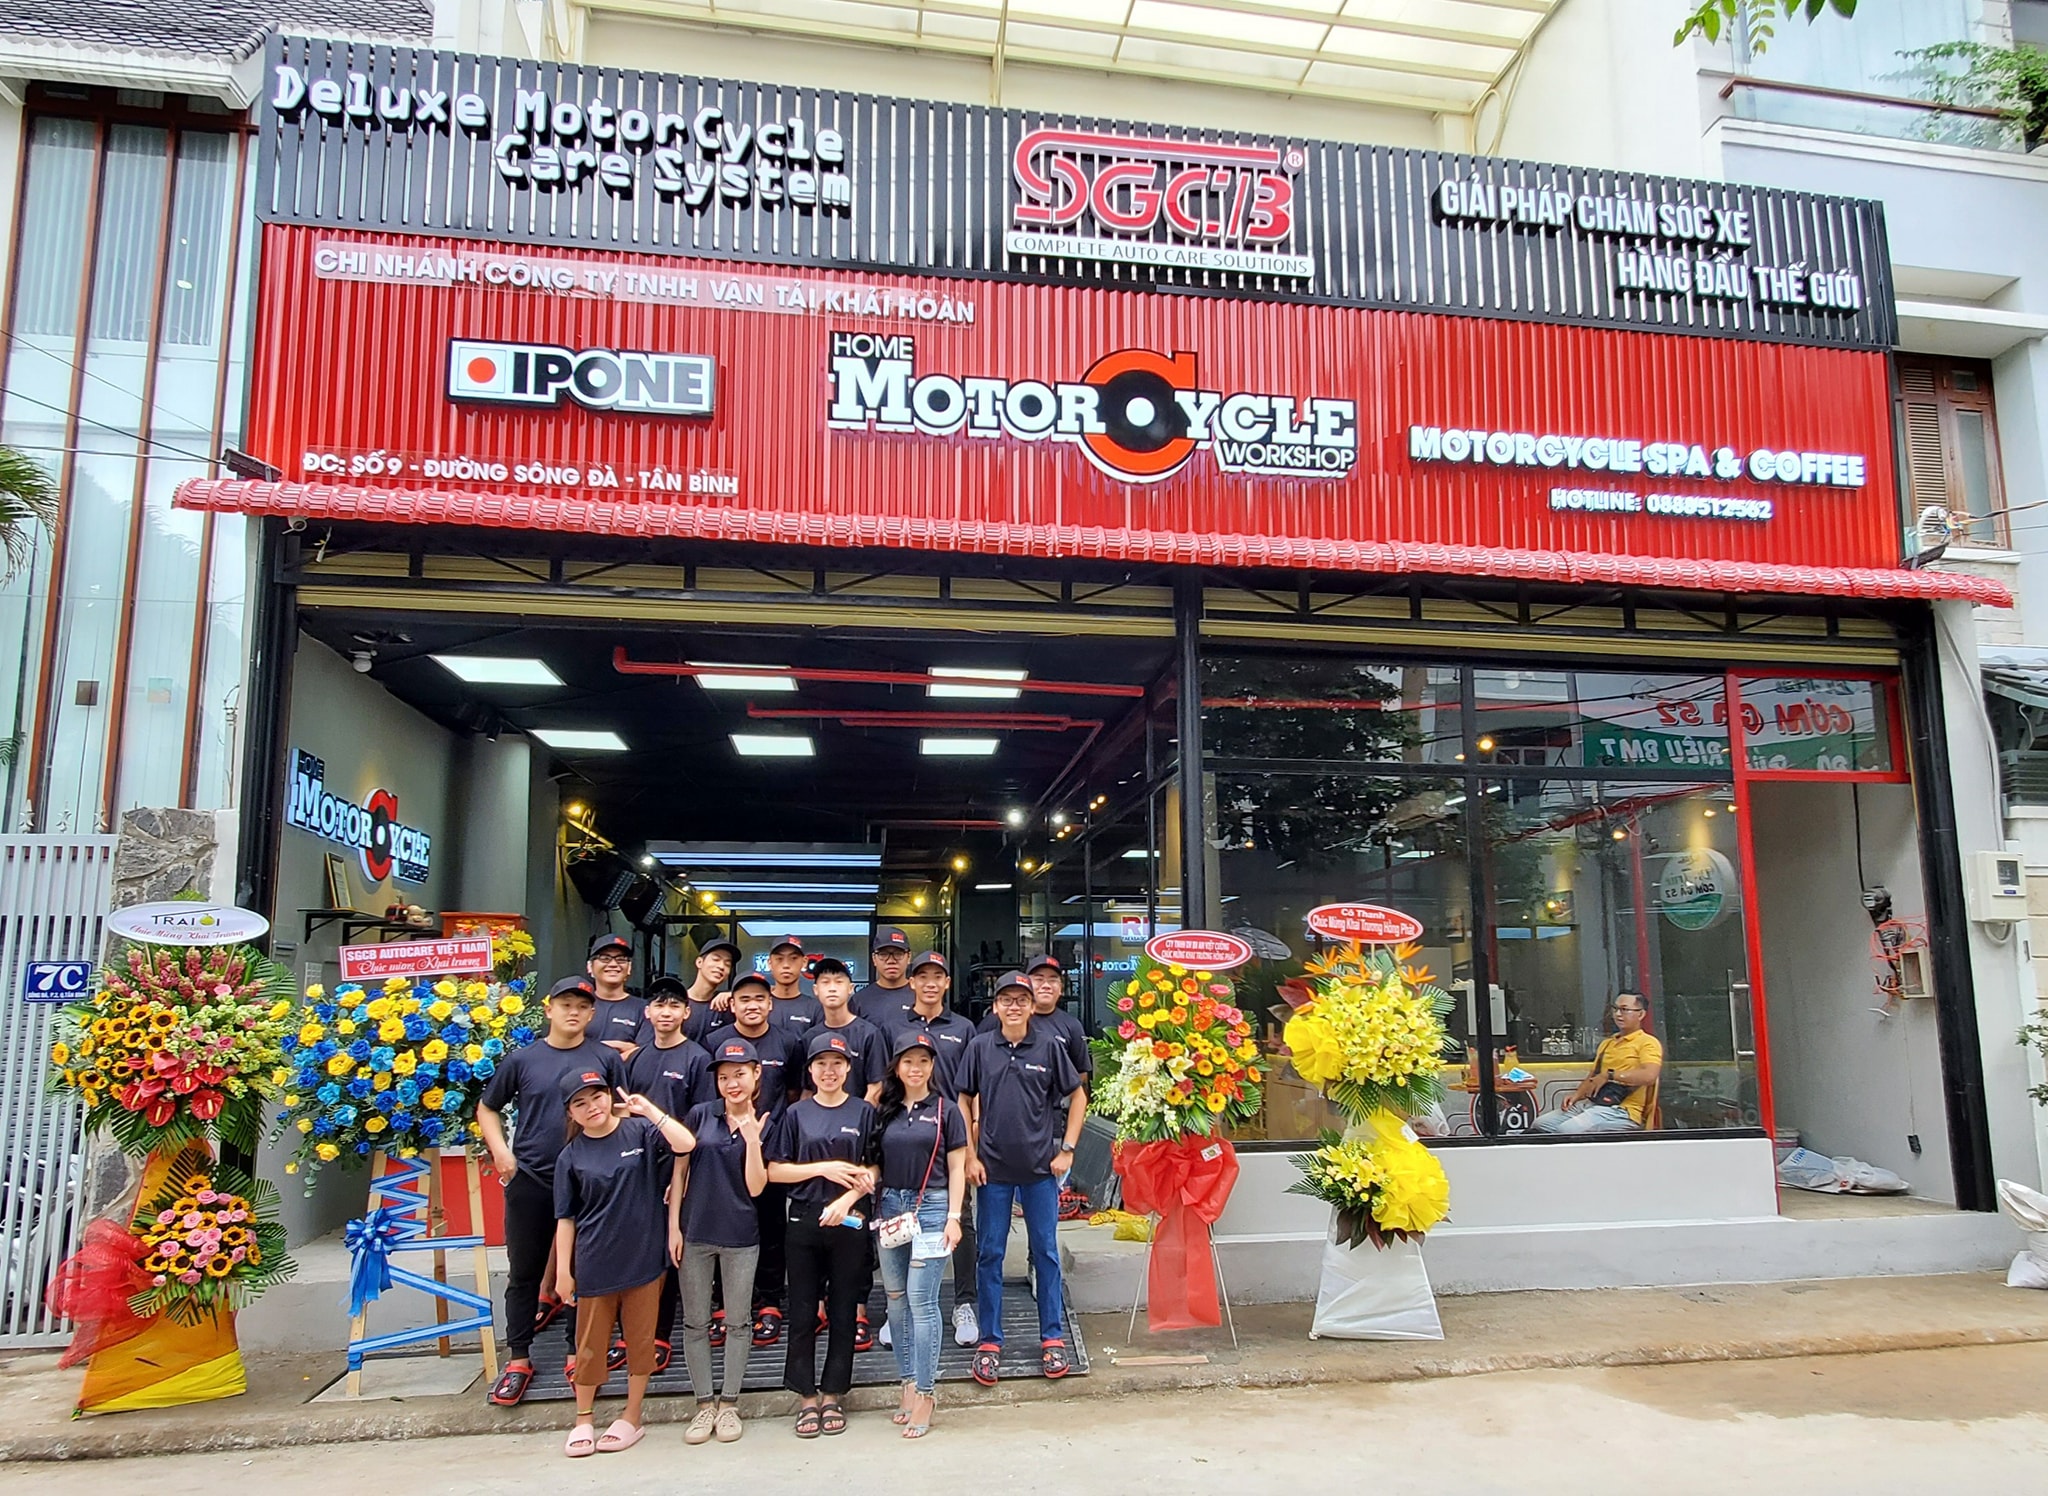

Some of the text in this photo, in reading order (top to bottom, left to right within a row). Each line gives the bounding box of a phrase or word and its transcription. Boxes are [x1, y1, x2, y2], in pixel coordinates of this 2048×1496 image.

[273, 66, 844, 162] Deluxe MotorCycle
[495, 134, 852, 206] Care System
[1440, 172, 1752, 244] GIẢI PHÁP CHĂM SÓC XE
[1013, 236, 1308, 274] COMPLETE AUTO CARE SOLUTIONS
[314, 249, 974, 323] CHI NHÁNH CÔNG TY TNHH VẬN TẢI KHẢI HOÀN
[1617, 247, 1861, 309] HÀNG ĐẦU THẾ GIỚI
[834, 334, 913, 358] HOME
[513, 351, 705, 405] IPONE
[303, 452, 346, 474] ĐC:
[352, 450, 386, 475] SỐ
[387, 457, 403, 476] 9
[423, 456, 509, 483] ĐƯỜNG
[514, 462, 580, 486] SÔNG
[587, 464, 619, 488] ĐÀ
[638, 468, 682, 492] TÂN
[688, 469, 738, 495] BÌNH
[1221, 440, 1356, 472] WORKSHOP
[1410, 425, 1866, 487] MOTORCYCLE SPA & COFFEE
[1550, 488, 1642, 512] HOTLINE:
[1356, 909, 1386, 919] Thanh
[346, 943, 487, 962] SGCB AUTOCARE VIỆT NAM
[33, 965, 83, 991] 7C
